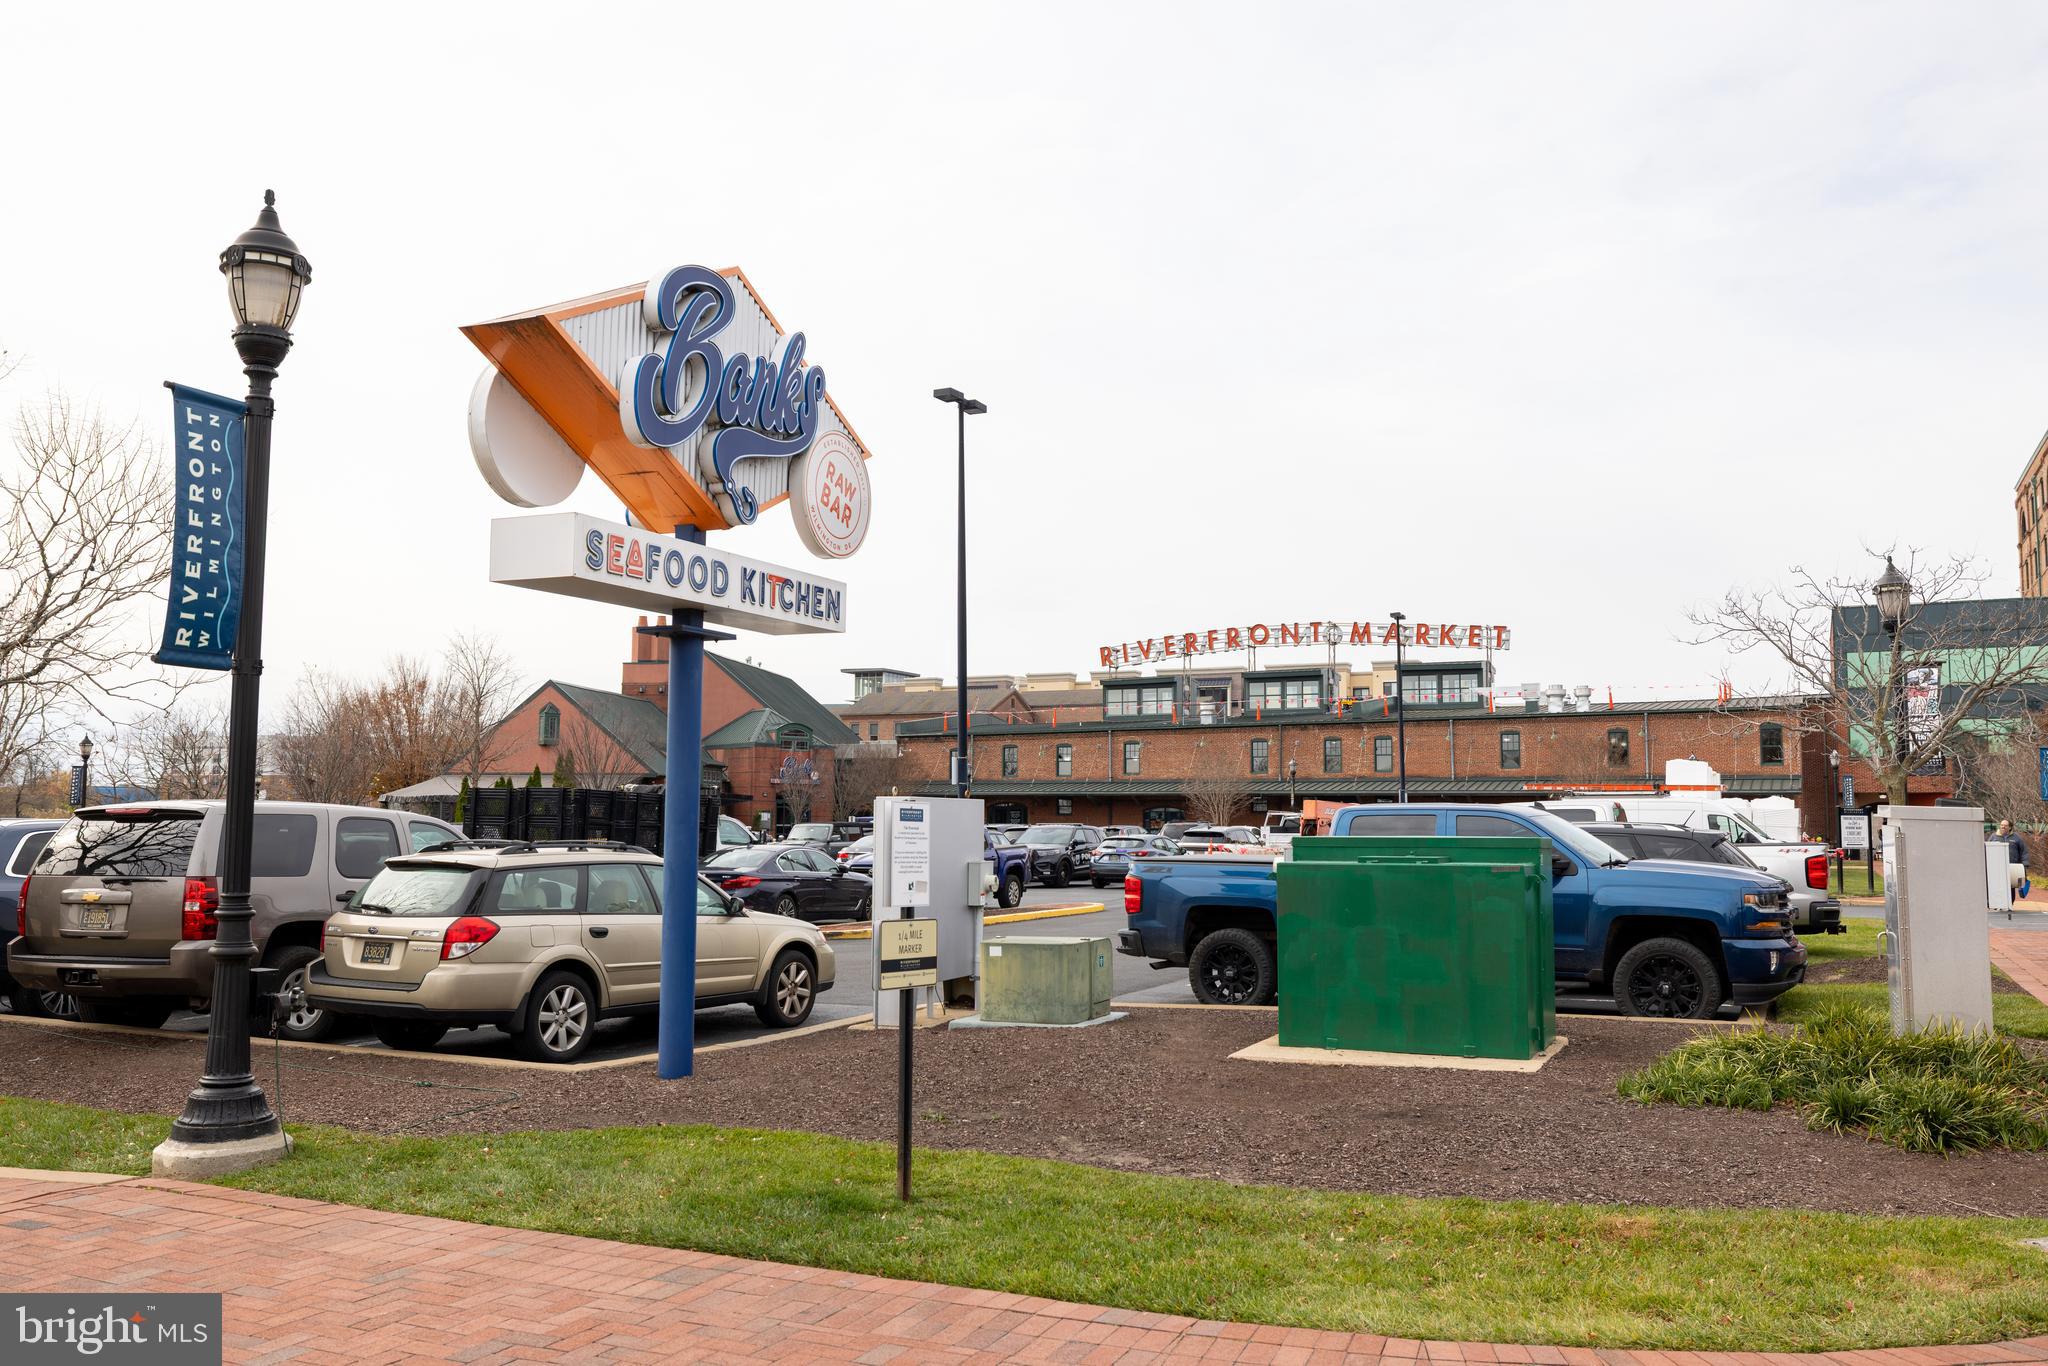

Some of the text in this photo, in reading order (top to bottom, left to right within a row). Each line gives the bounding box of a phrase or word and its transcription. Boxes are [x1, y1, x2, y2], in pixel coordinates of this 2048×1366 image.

[620, 264, 826, 525] Banks
[820, 482, 852, 528] BAR
[826, 461, 857, 503] RAW
[175, 406, 205, 648] RIVERFRONT
[198, 414, 222, 648] WILMINGTON
[585, 527, 841, 624] SEAFOOD KITCHEN
[1099, 621, 1507, 667] RIVERFRONT MARKET
[898, 929, 924, 942] 1/4 MILE
[898, 943, 923, 955] MARKER
